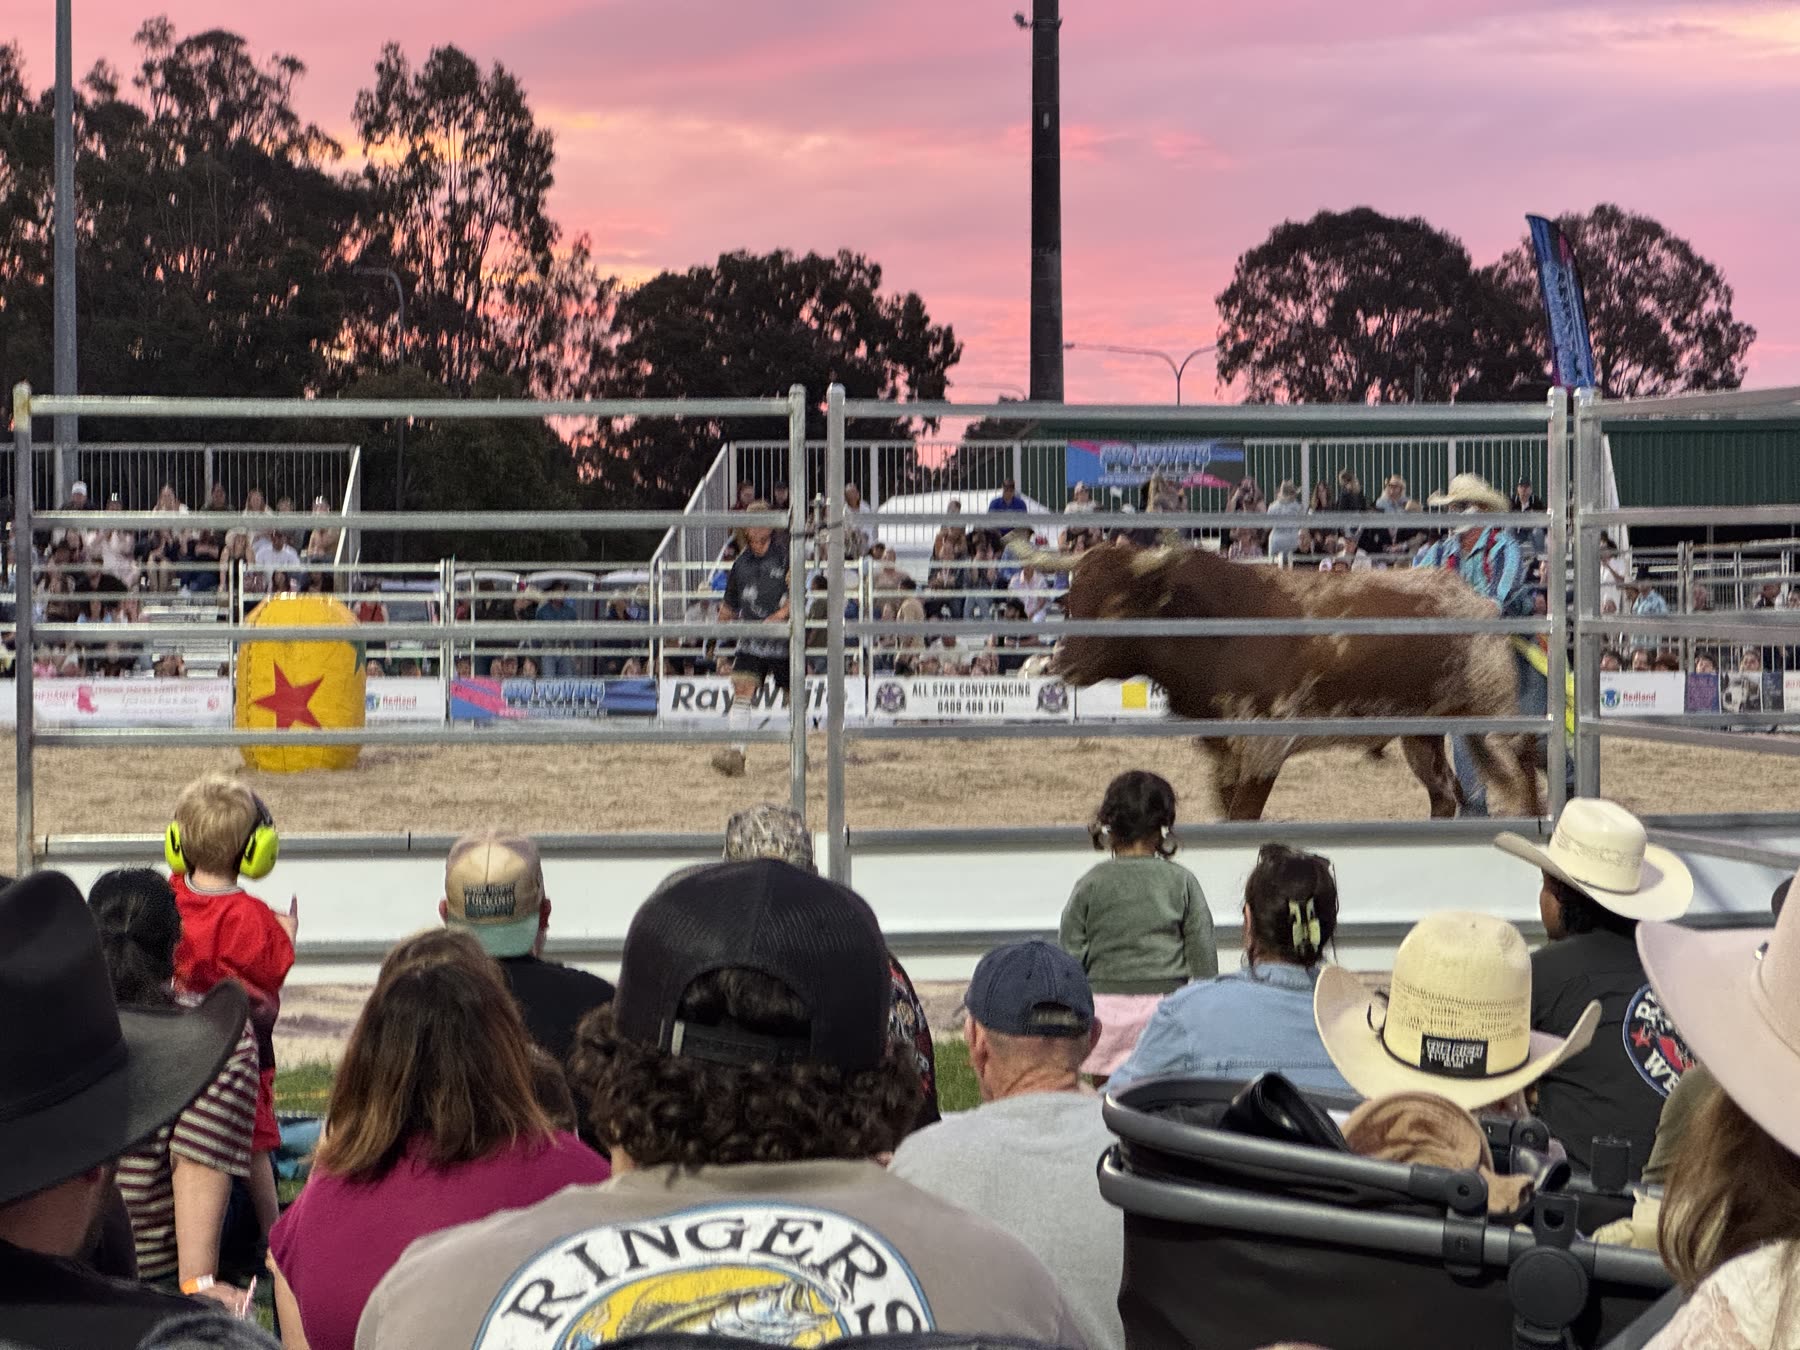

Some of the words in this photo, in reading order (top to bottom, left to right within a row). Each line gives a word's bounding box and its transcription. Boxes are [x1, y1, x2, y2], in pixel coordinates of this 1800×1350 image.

[912, 682, 928, 697] ALL
[932, 682, 956, 697] STAR
[959, 682, 1031, 698] CONVEYANCING
[672, 683, 735, 717] Ray
[988, 699, 1005, 714] 101
